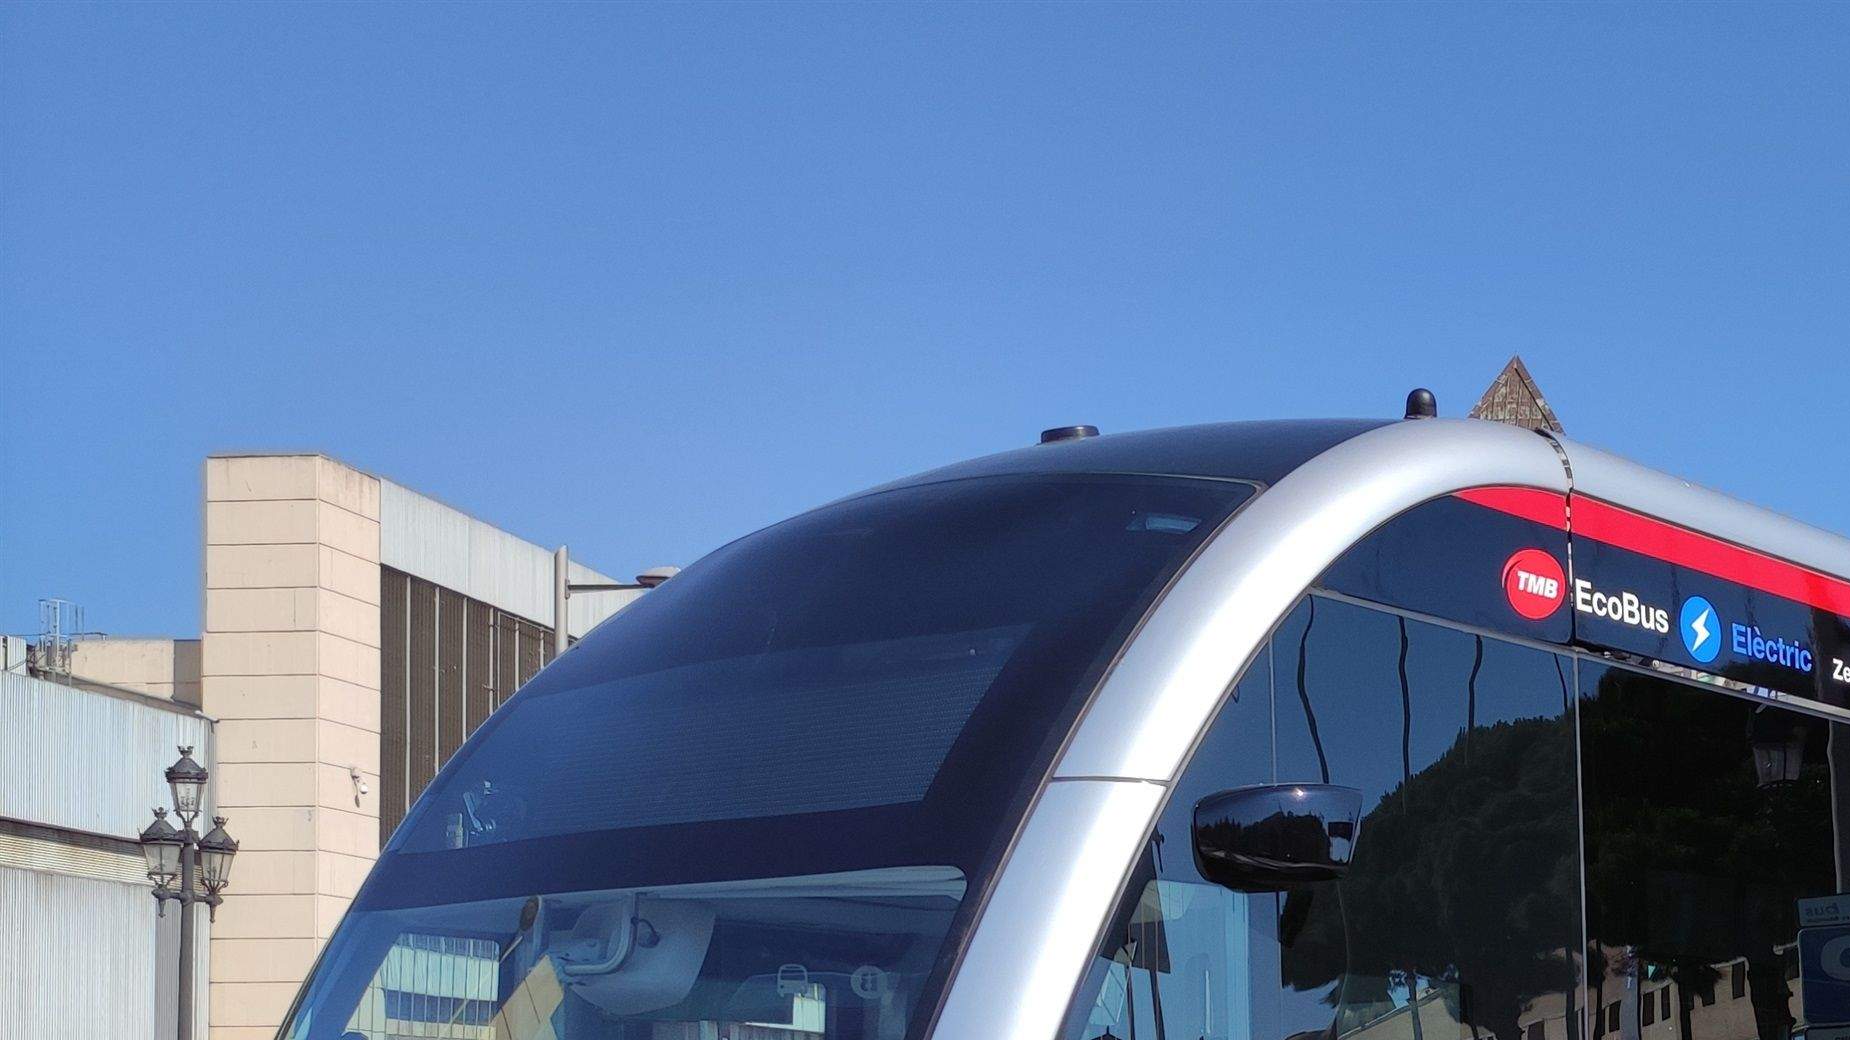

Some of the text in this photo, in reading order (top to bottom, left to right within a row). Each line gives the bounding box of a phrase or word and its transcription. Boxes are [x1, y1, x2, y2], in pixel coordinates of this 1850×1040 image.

[1517, 571, 1559, 600] TMB
[1574, 578, 1669, 634] EcoBus
[1731, 622, 1813, 673] Elèctric
